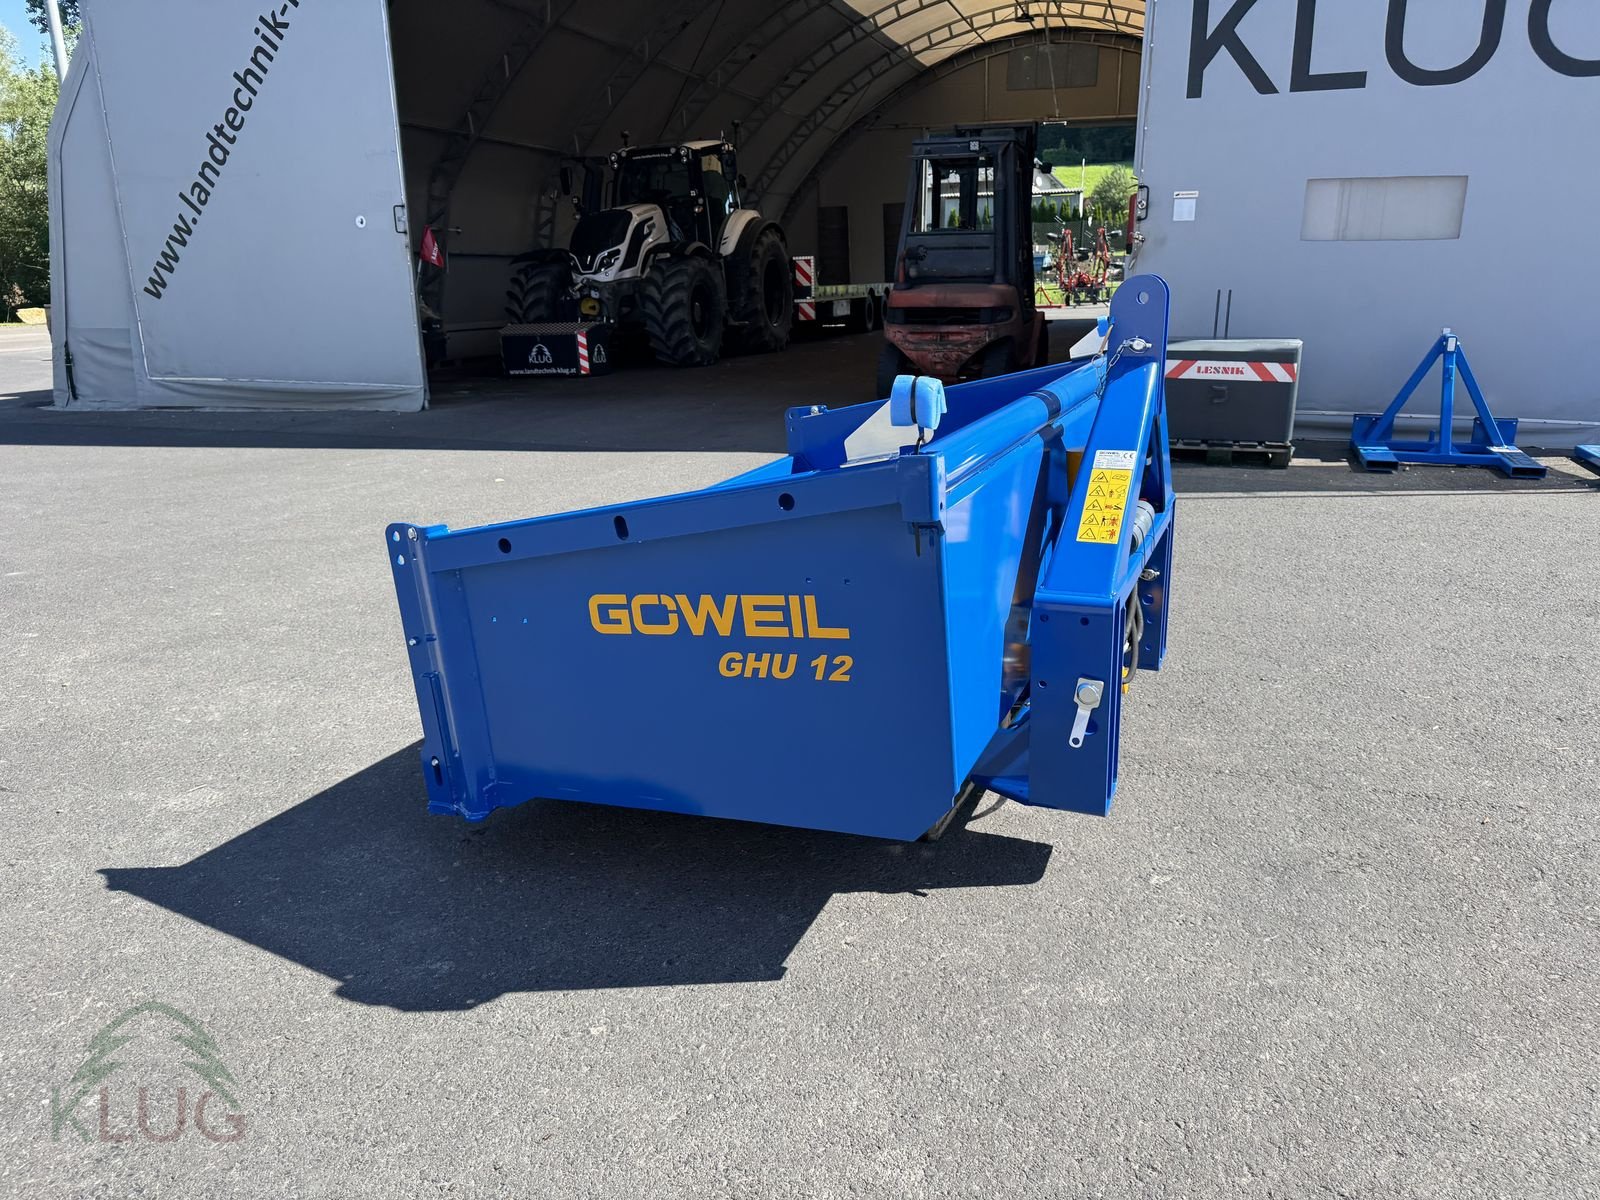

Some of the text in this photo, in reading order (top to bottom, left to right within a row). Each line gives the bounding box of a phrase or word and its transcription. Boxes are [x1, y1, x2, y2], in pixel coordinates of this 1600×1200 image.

[528, 355, 553, 363] KLUG
[1196, 366, 1245, 375] LESNIK
[718, 652, 853, 682] GHU 12
